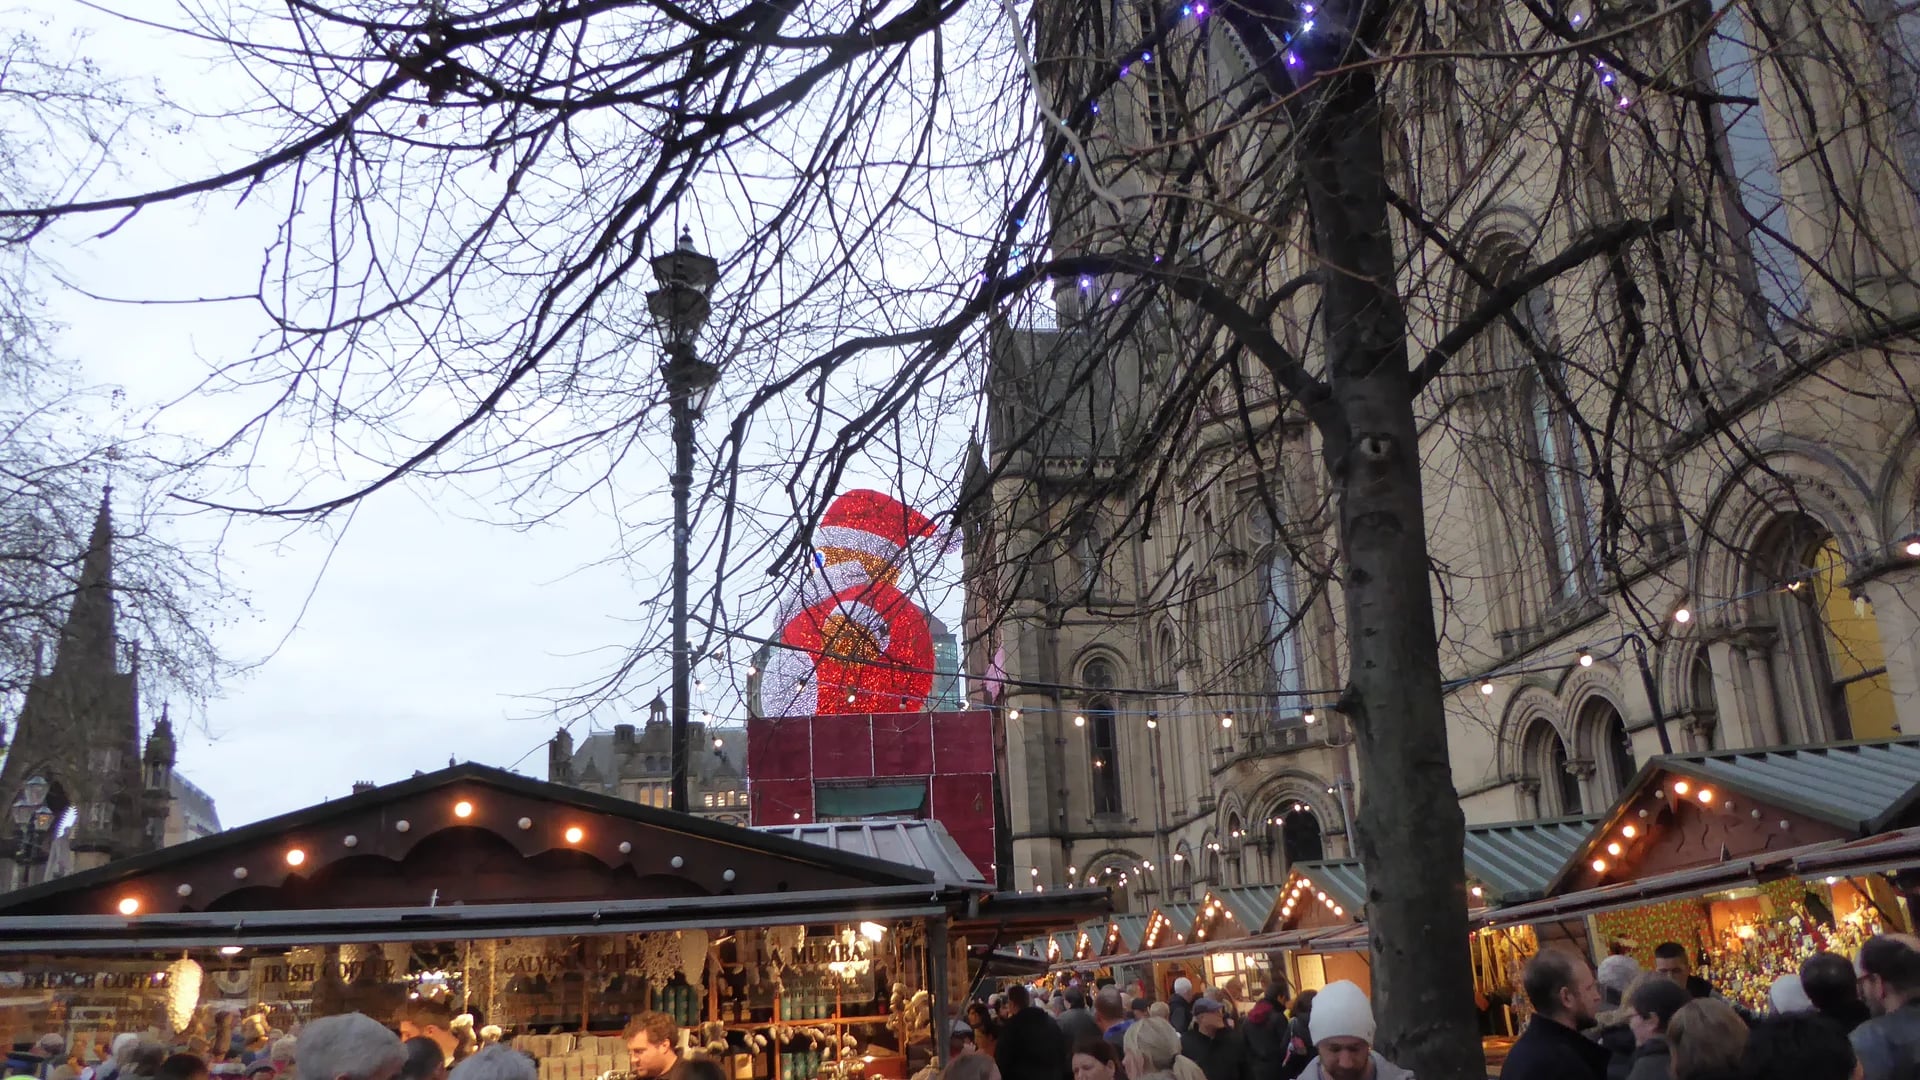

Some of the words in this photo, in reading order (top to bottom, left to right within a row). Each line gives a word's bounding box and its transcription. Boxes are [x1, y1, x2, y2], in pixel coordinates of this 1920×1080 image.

[263, 962, 315, 983] IRISH
[322, 959, 396, 981] COFFE
[504, 956, 582, 973] CALYPS
[22, 971, 94, 989] FRENCH
